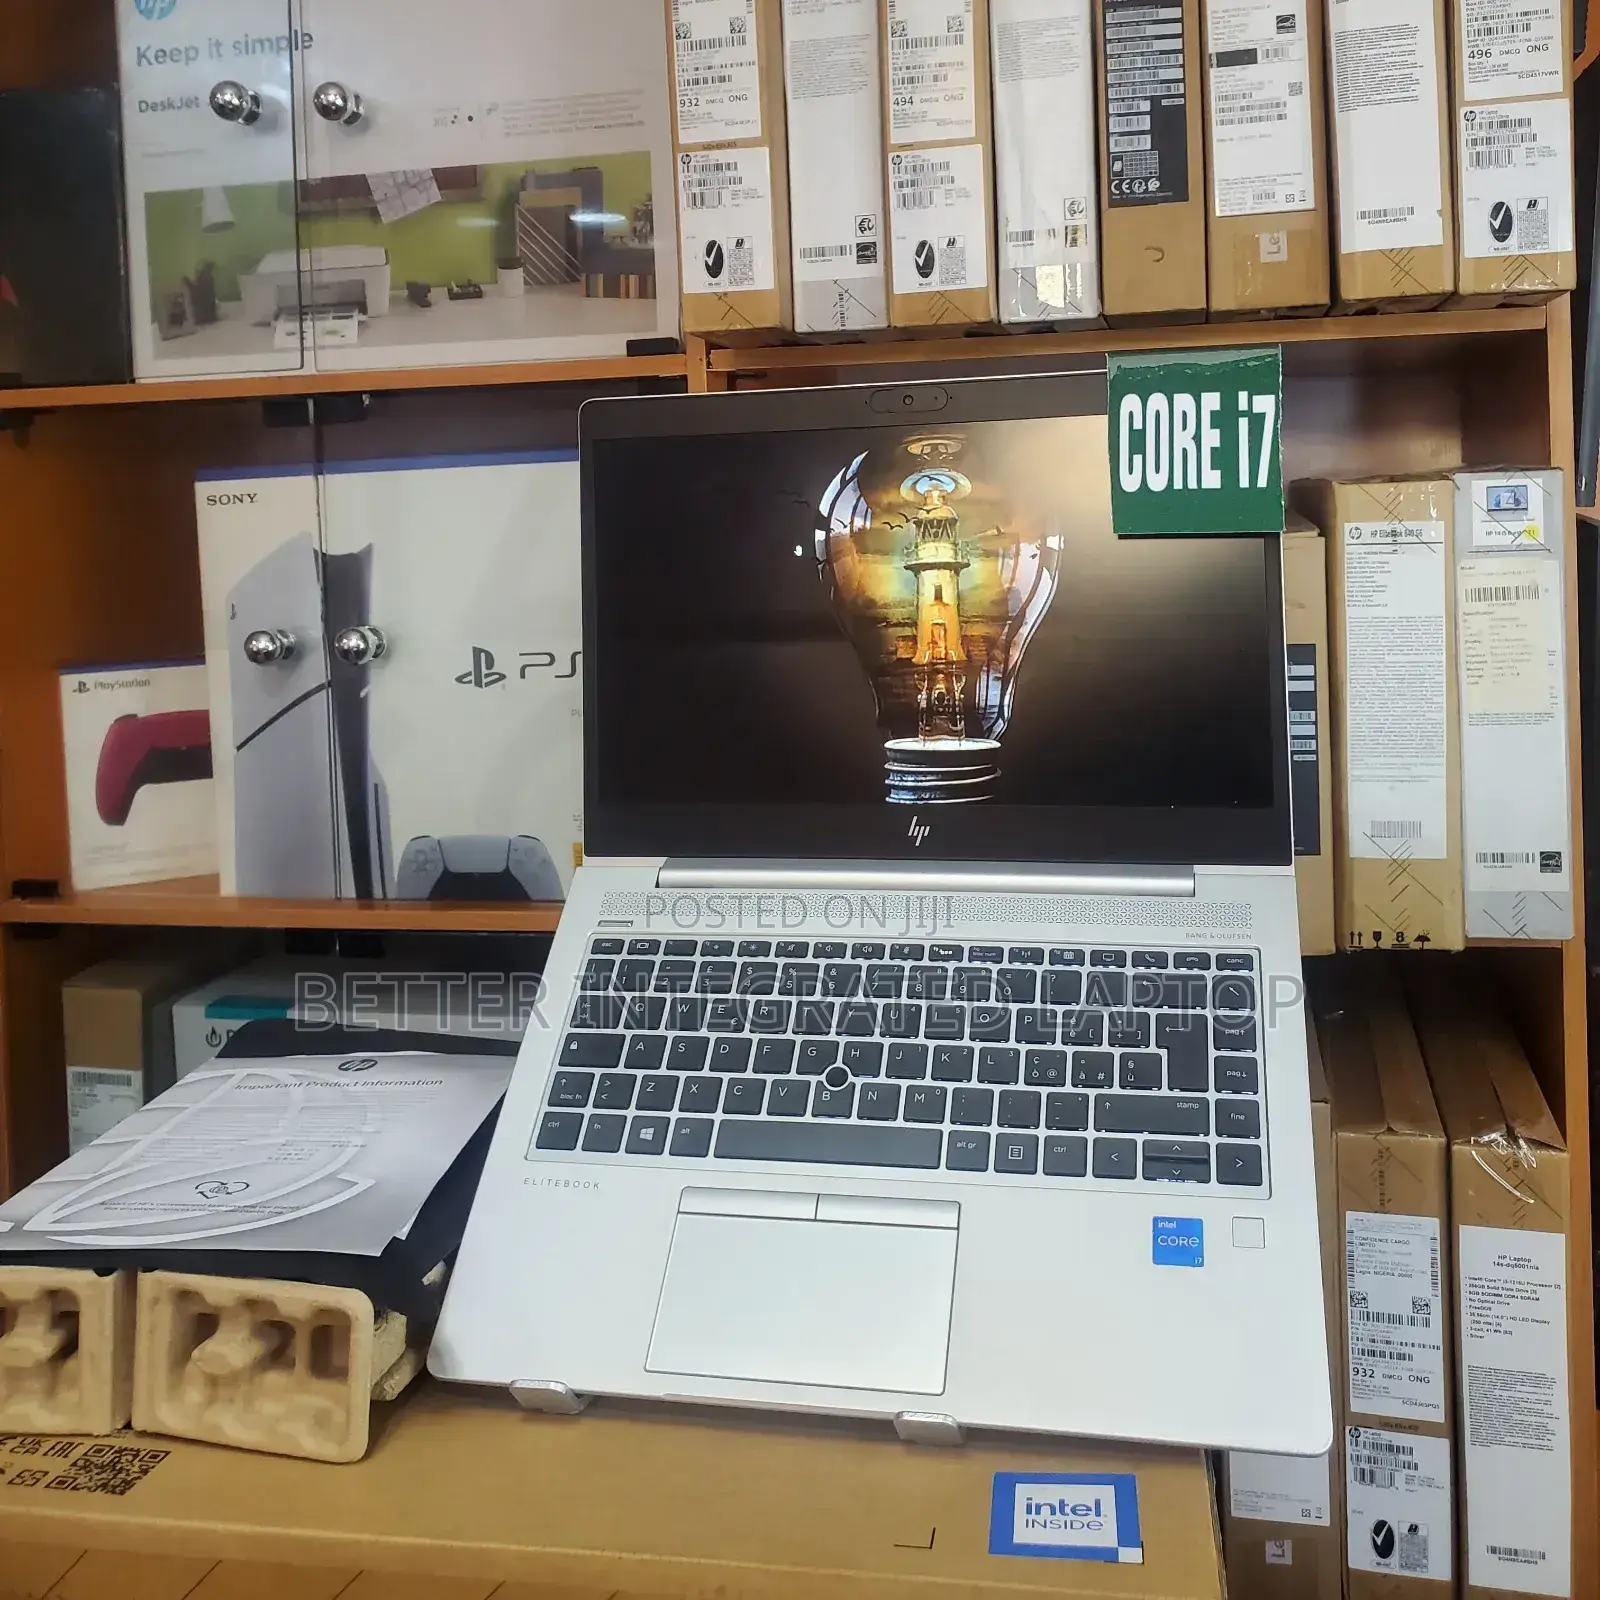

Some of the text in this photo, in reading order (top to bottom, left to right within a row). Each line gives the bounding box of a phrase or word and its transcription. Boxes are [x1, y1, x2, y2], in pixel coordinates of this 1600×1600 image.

[136, 29, 314, 67] Keep it simple
[1468, 49, 1492, 59] 496
[1526, 44, 1549, 53] ONG
[138, 97, 200, 113] DeskJet
[679, 97, 700, 108] 932
[728, 94, 748, 103] ONG
[892, 96, 914, 106] 494
[1120, 391, 1276, 492] CORE i7
[206, 493, 258, 506] SONY
[94, 678, 150, 692] PlayStation
[1185, 932, 1206, 940] BANG
[788, 968, 797, 976] %
[830, 968, 838, 976] &
[786, 980, 793, 989] 5
[828, 981, 835, 989] 6
[871, 982, 878, 991] 7
[915, 983, 923, 992] 8
[959, 985, 966, 994] 9
[635, 1003, 645, 1013] Q
[677, 1004, 691, 1013] W
[718, 1005, 725, 1014] E
[760, 1005, 768, 1015] R
[803, 1007, 811, 1016] T
[848, 1009, 856, 1017] Y
[890, 1010, 898, 1019] U
[979, 1013, 989, 1023] O
[1024, 1015, 1033, 1025] P
[1225, 1028, 1240, 1037] pag
[635, 1041, 645, 1051] A
[678, 1042, 686, 1052] S
[720, 1044, 729, 1054] D
[763, 1046, 771, 1055] F
[808, 1047, 817, 1057] G
[851, 1049, 860, 1058] H
[895, 1050, 902, 1060] J
[941, 1052, 950, 1062] K
[987, 1055, 995, 1064] L
[1226, 1070, 1241, 1079] pag
[234, 1078, 444, 1091] Important Product Information
[646, 1082, 655, 1092] Z
[689, 1084, 698, 1093] X
[733, 1086, 743, 1095] C
[778, 1087, 788, 1097] V
[868, 1091, 877, 1100] N
[822, 1091, 831, 1101] B
[914, 1093, 925, 1103] M
[1176, 1101, 1200, 1111] stamp
[1230, 1112, 1246, 1120] fine
[594, 1122, 601, 1130] fn
[956, 1140, 976, 1150] alt gr
[523, 1177, 601, 1190] ELITEBOOK
[1158, 1220, 1176, 1228] intel
[1509, 1255, 1531, 1263] Laptop
[1352, 1367, 1375, 1378] 932
[1408, 1375, 1430, 1384] ONG
[1025, 1496, 1102, 1517] intel
